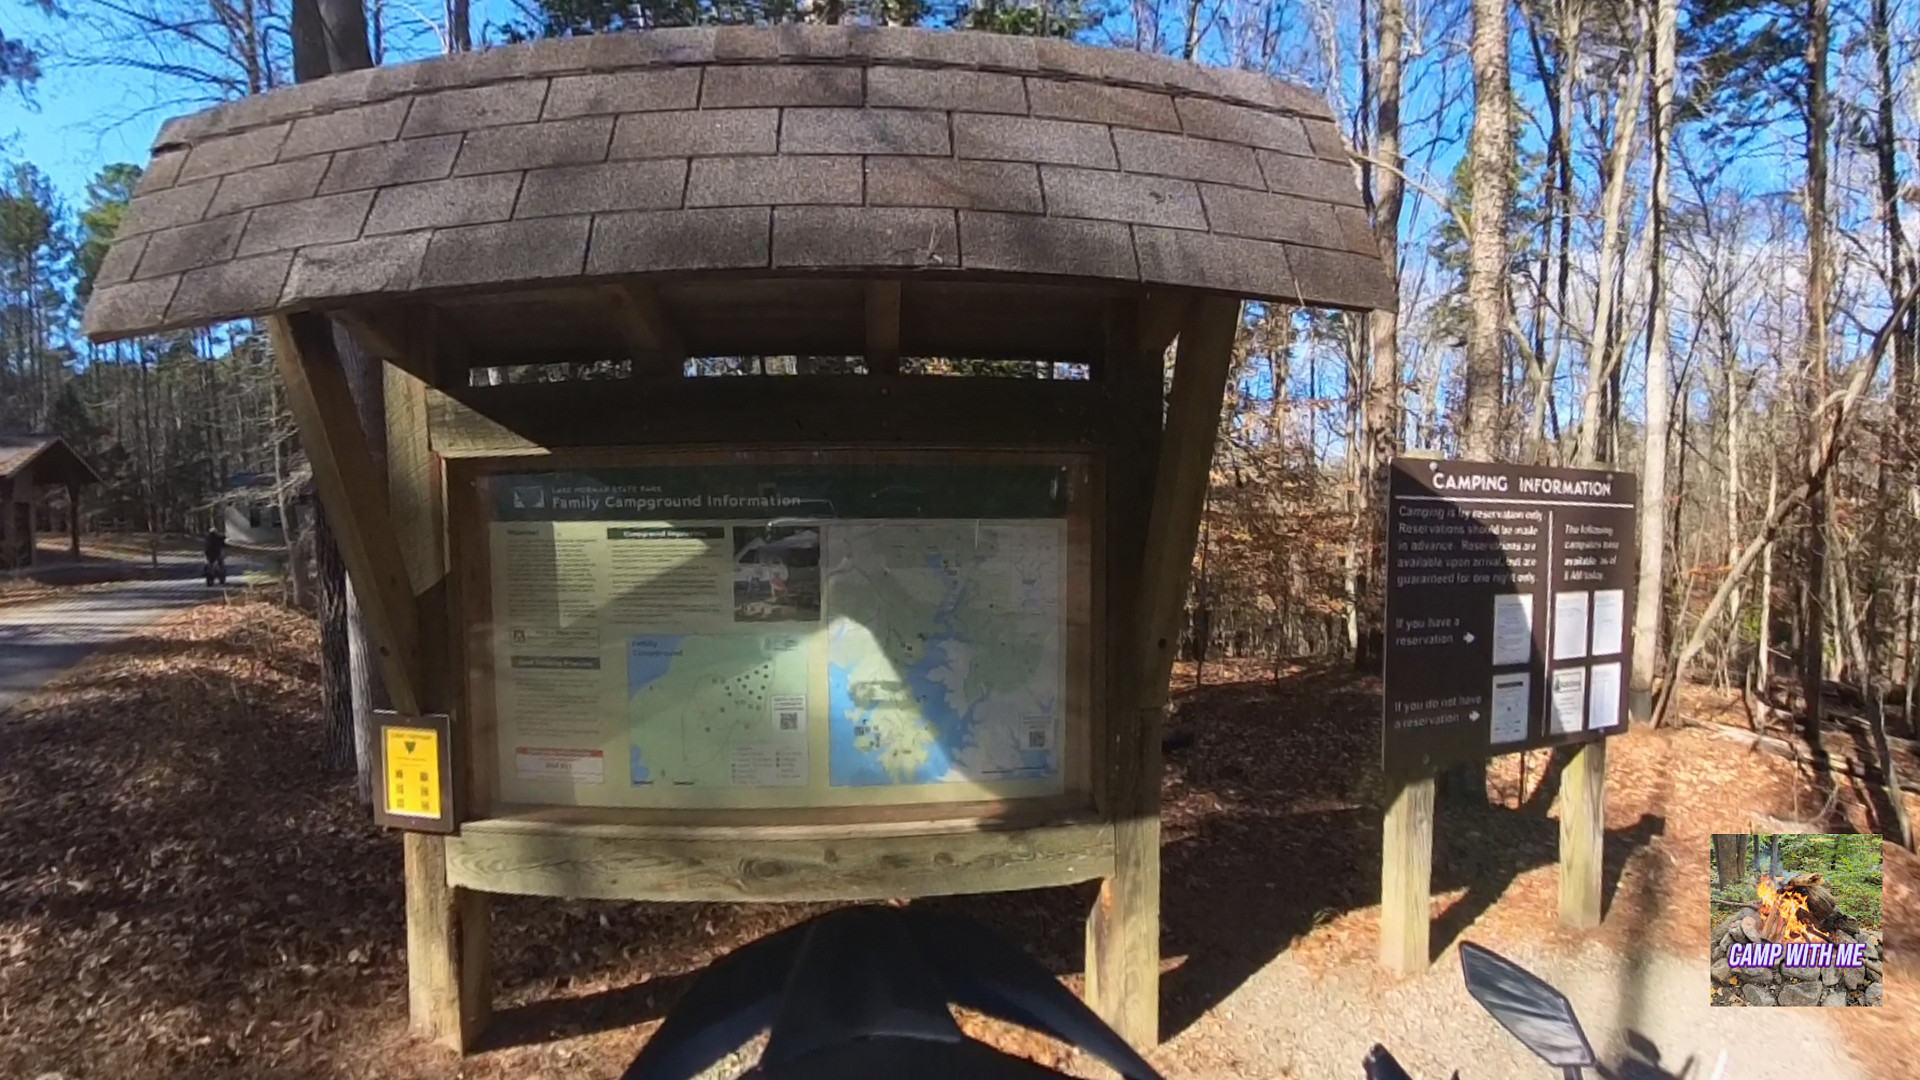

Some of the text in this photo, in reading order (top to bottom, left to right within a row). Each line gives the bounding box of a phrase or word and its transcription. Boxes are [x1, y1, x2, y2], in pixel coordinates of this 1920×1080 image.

[1432, 472, 1612, 496] CAMPING INFORMATION
[552, 495, 801, 512] Family Campground Information
[1398, 505, 1445, 520] Camping
[1447, 507, 1456, 518] is
[1472, 508, 1525, 520] reservation
[1398, 523, 1465, 535] Reservations
[1564, 523, 1580, 534] The
[1396, 557, 1442, 568] available
[1445, 557, 1470, 570] upon
[1396, 573, 1455, 588] guaranteed
[1456, 572, 1470, 584] for
[1472, 573, 1490, 583] one
[1405, 619, 1426, 632] you
[1427, 616, 1452, 628] have
[1395, 633, 1454, 646] reservation
[1403, 701, 1424, 715] you
[1425, 698, 1439, 709] do
[1441, 696, 1457, 707] not
[1458, 694, 1483, 706] have
[1402, 713, 1460, 728] reservation
